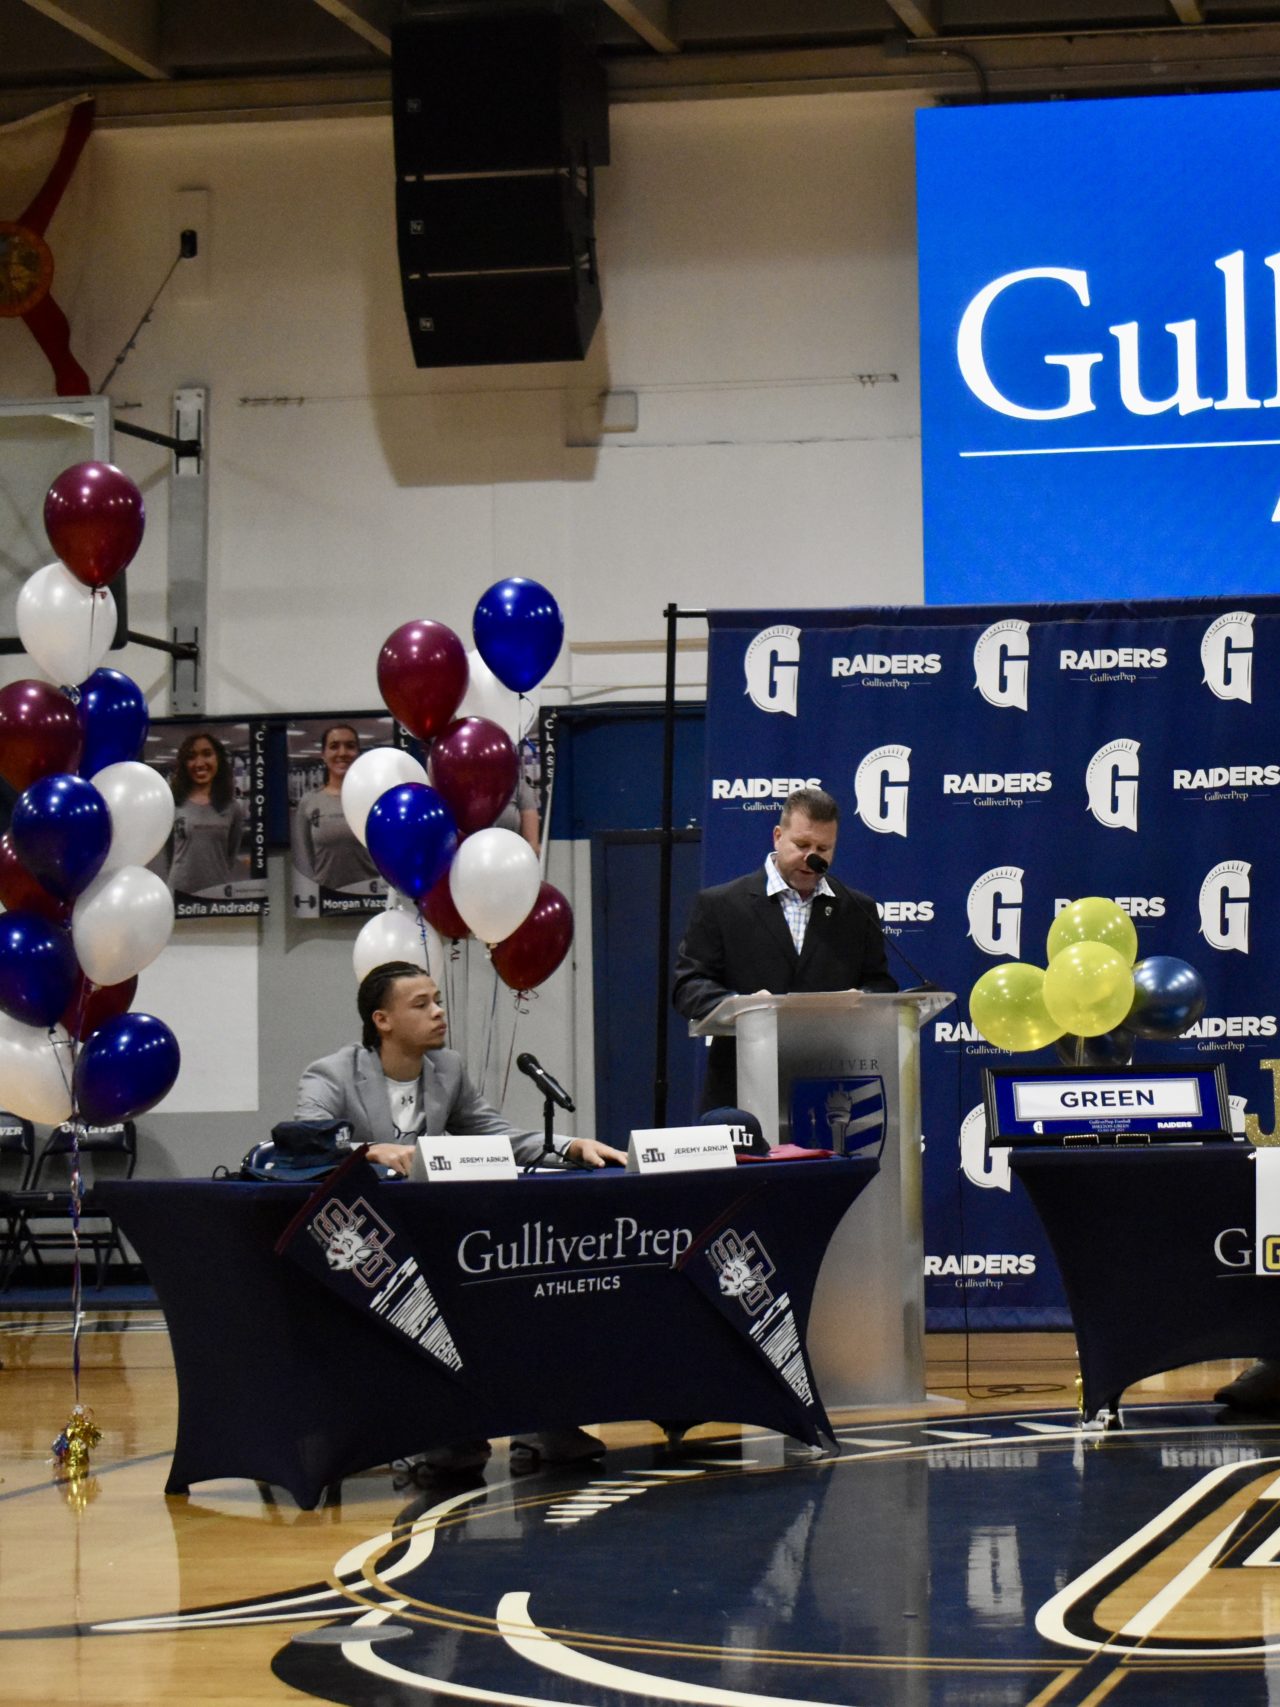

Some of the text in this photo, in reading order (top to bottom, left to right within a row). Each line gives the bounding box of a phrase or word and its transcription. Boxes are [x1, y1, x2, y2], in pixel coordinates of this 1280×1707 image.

[832, 654, 941, 677] RAIDERS
[1060, 648, 1167, 669] RAIDERS
[862, 678, 909, 689] GulliverPrep
[1090, 672, 1136, 683] GulliverPrep
[544, 719, 555, 778] CLASS
[255, 731, 265, 789] CLASS
[944, 772, 1052, 793] RAIDERS
[1174, 765, 1280, 789] RAIDERS
[974, 797, 1023, 807] GulliverPrep
[1205, 791, 1248, 801] GulliverPrep
[255, 824, 265, 869] 2023
[178, 902, 260, 915] Sofia Andrade
[323, 899, 360, 910] Morgan
[1179, 1016, 1277, 1038] AIDERS
[1198, 1041, 1244, 1052] GulliverPrep
[1061, 1090, 1154, 1107] GREEN
[459, 1156, 484, 1164] JEREMY
[674, 1144, 728, 1155] JEREMY ARNUM
[458, 1218, 692, 1270] GulliverPrep
[924, 1254, 1035, 1275] RAIDERS
[535, 1276, 620, 1297] ATHLETICS
[419, 1315, 464, 1371] UNIVERSITY
[781, 1350, 814, 1408] UNIVERSITY
